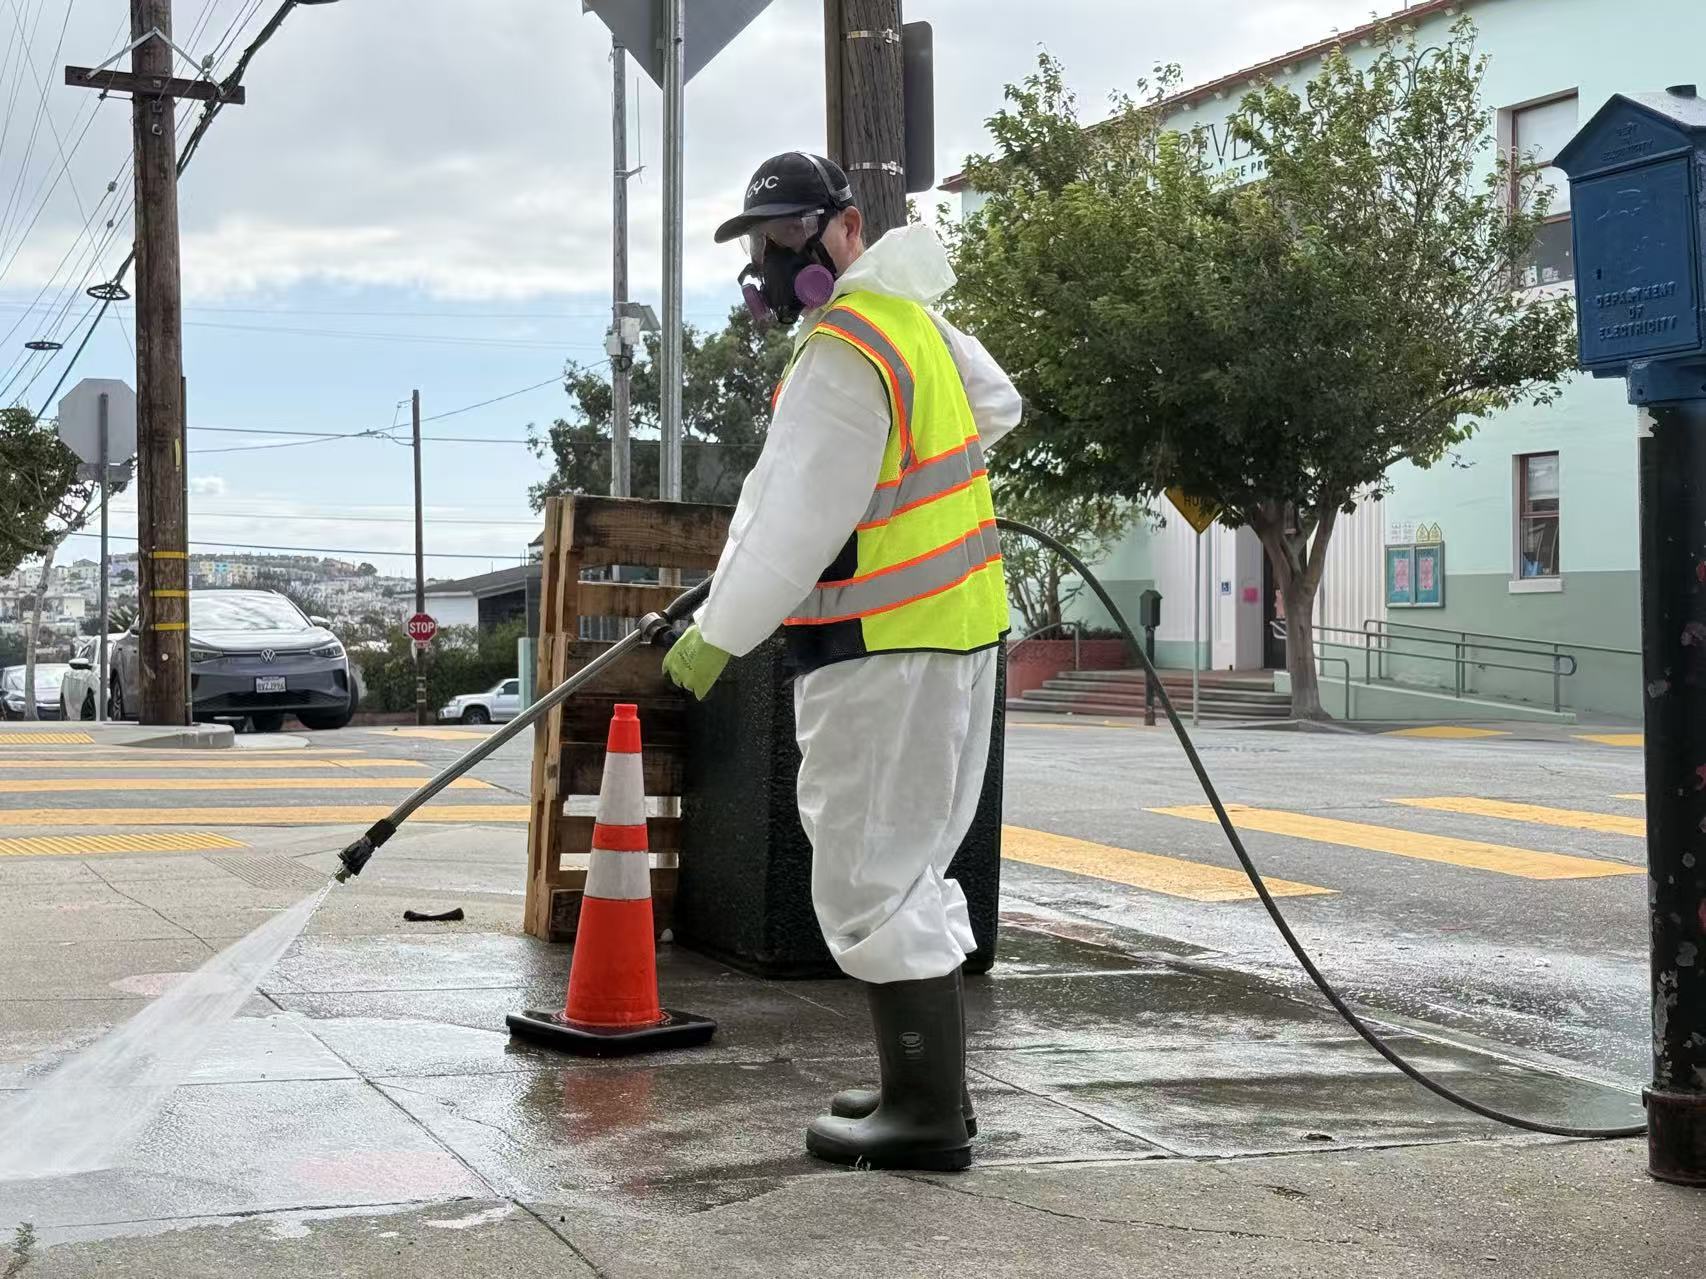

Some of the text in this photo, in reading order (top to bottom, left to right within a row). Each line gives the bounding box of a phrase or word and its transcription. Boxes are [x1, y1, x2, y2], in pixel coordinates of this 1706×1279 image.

[1596, 281, 1676, 308] DEPARTMENT
[1629, 304, 1644, 320] OF
[1599, 315, 1677, 340] ELECTRICITY
[409, 621, 434, 634] STOP
